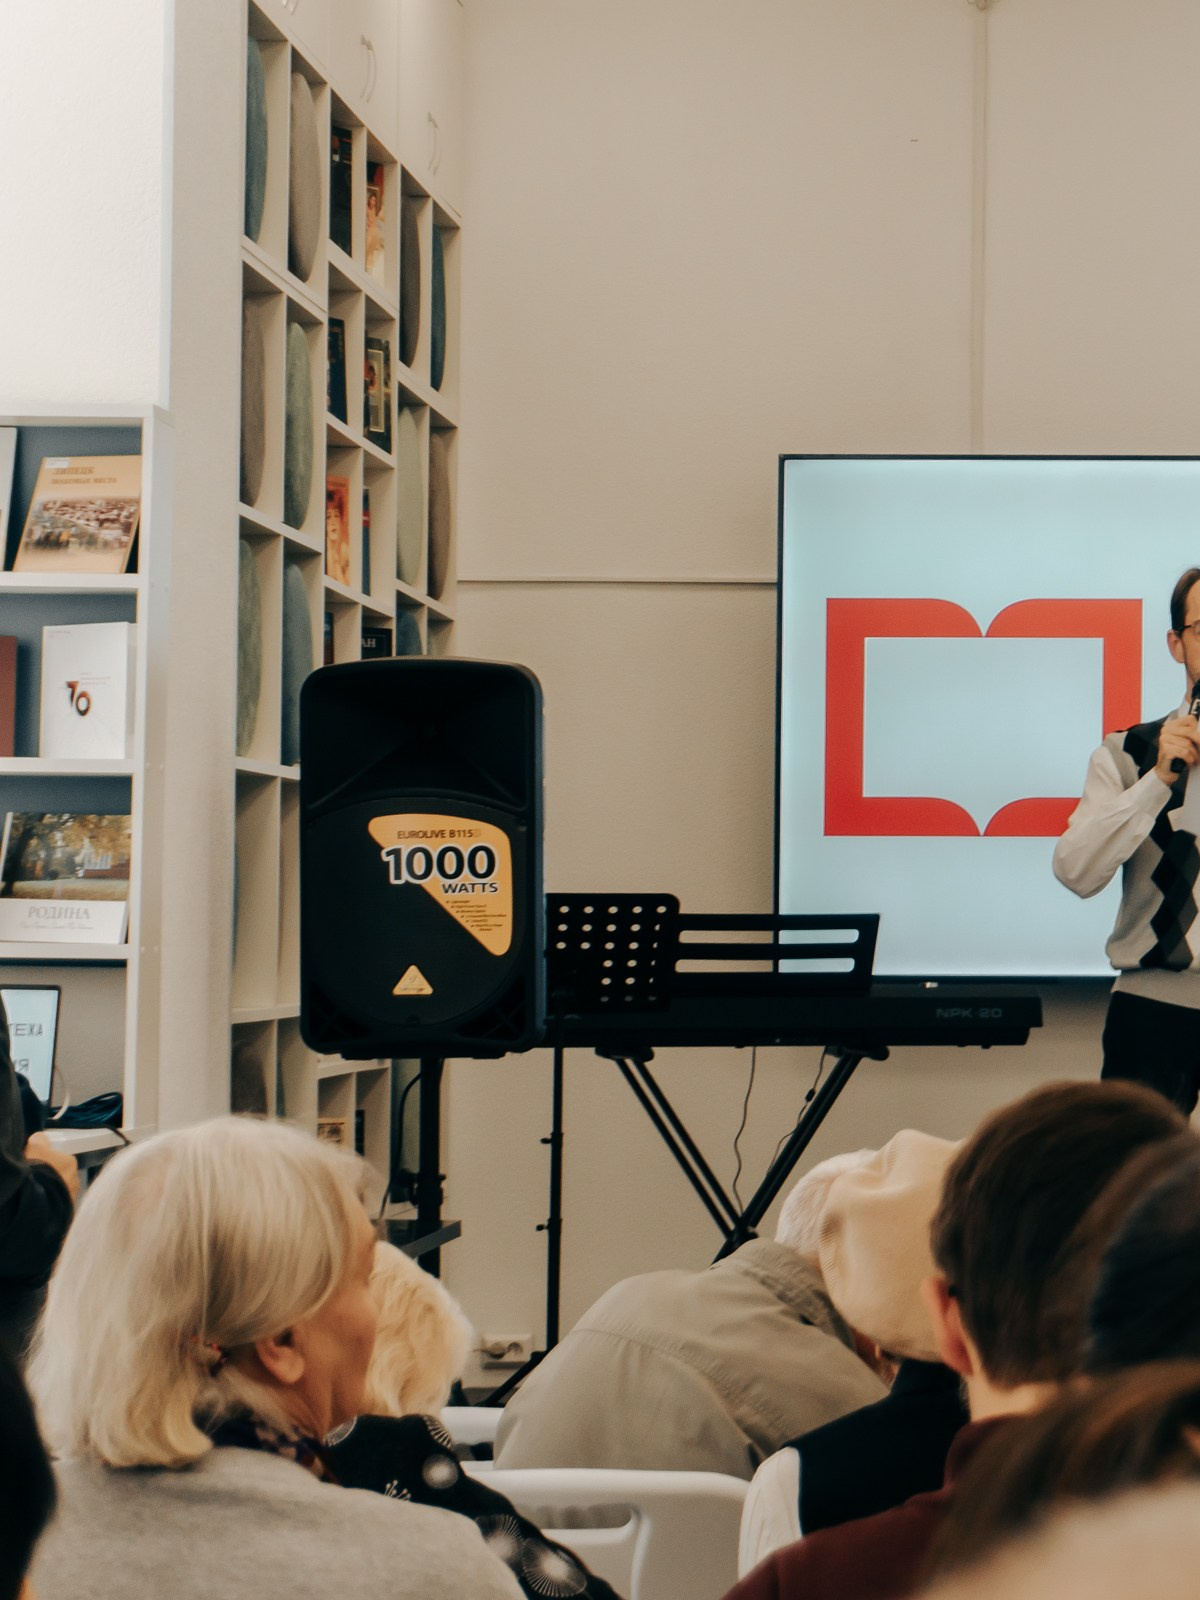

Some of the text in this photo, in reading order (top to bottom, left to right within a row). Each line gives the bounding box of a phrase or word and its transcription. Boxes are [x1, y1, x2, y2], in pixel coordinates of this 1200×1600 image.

[397, 829, 446, 839] EUROLIVE
[384, 844, 497, 882] 1000
[442, 882, 498, 894] WATTS
[27, 905, 90, 920] РОДИНА
